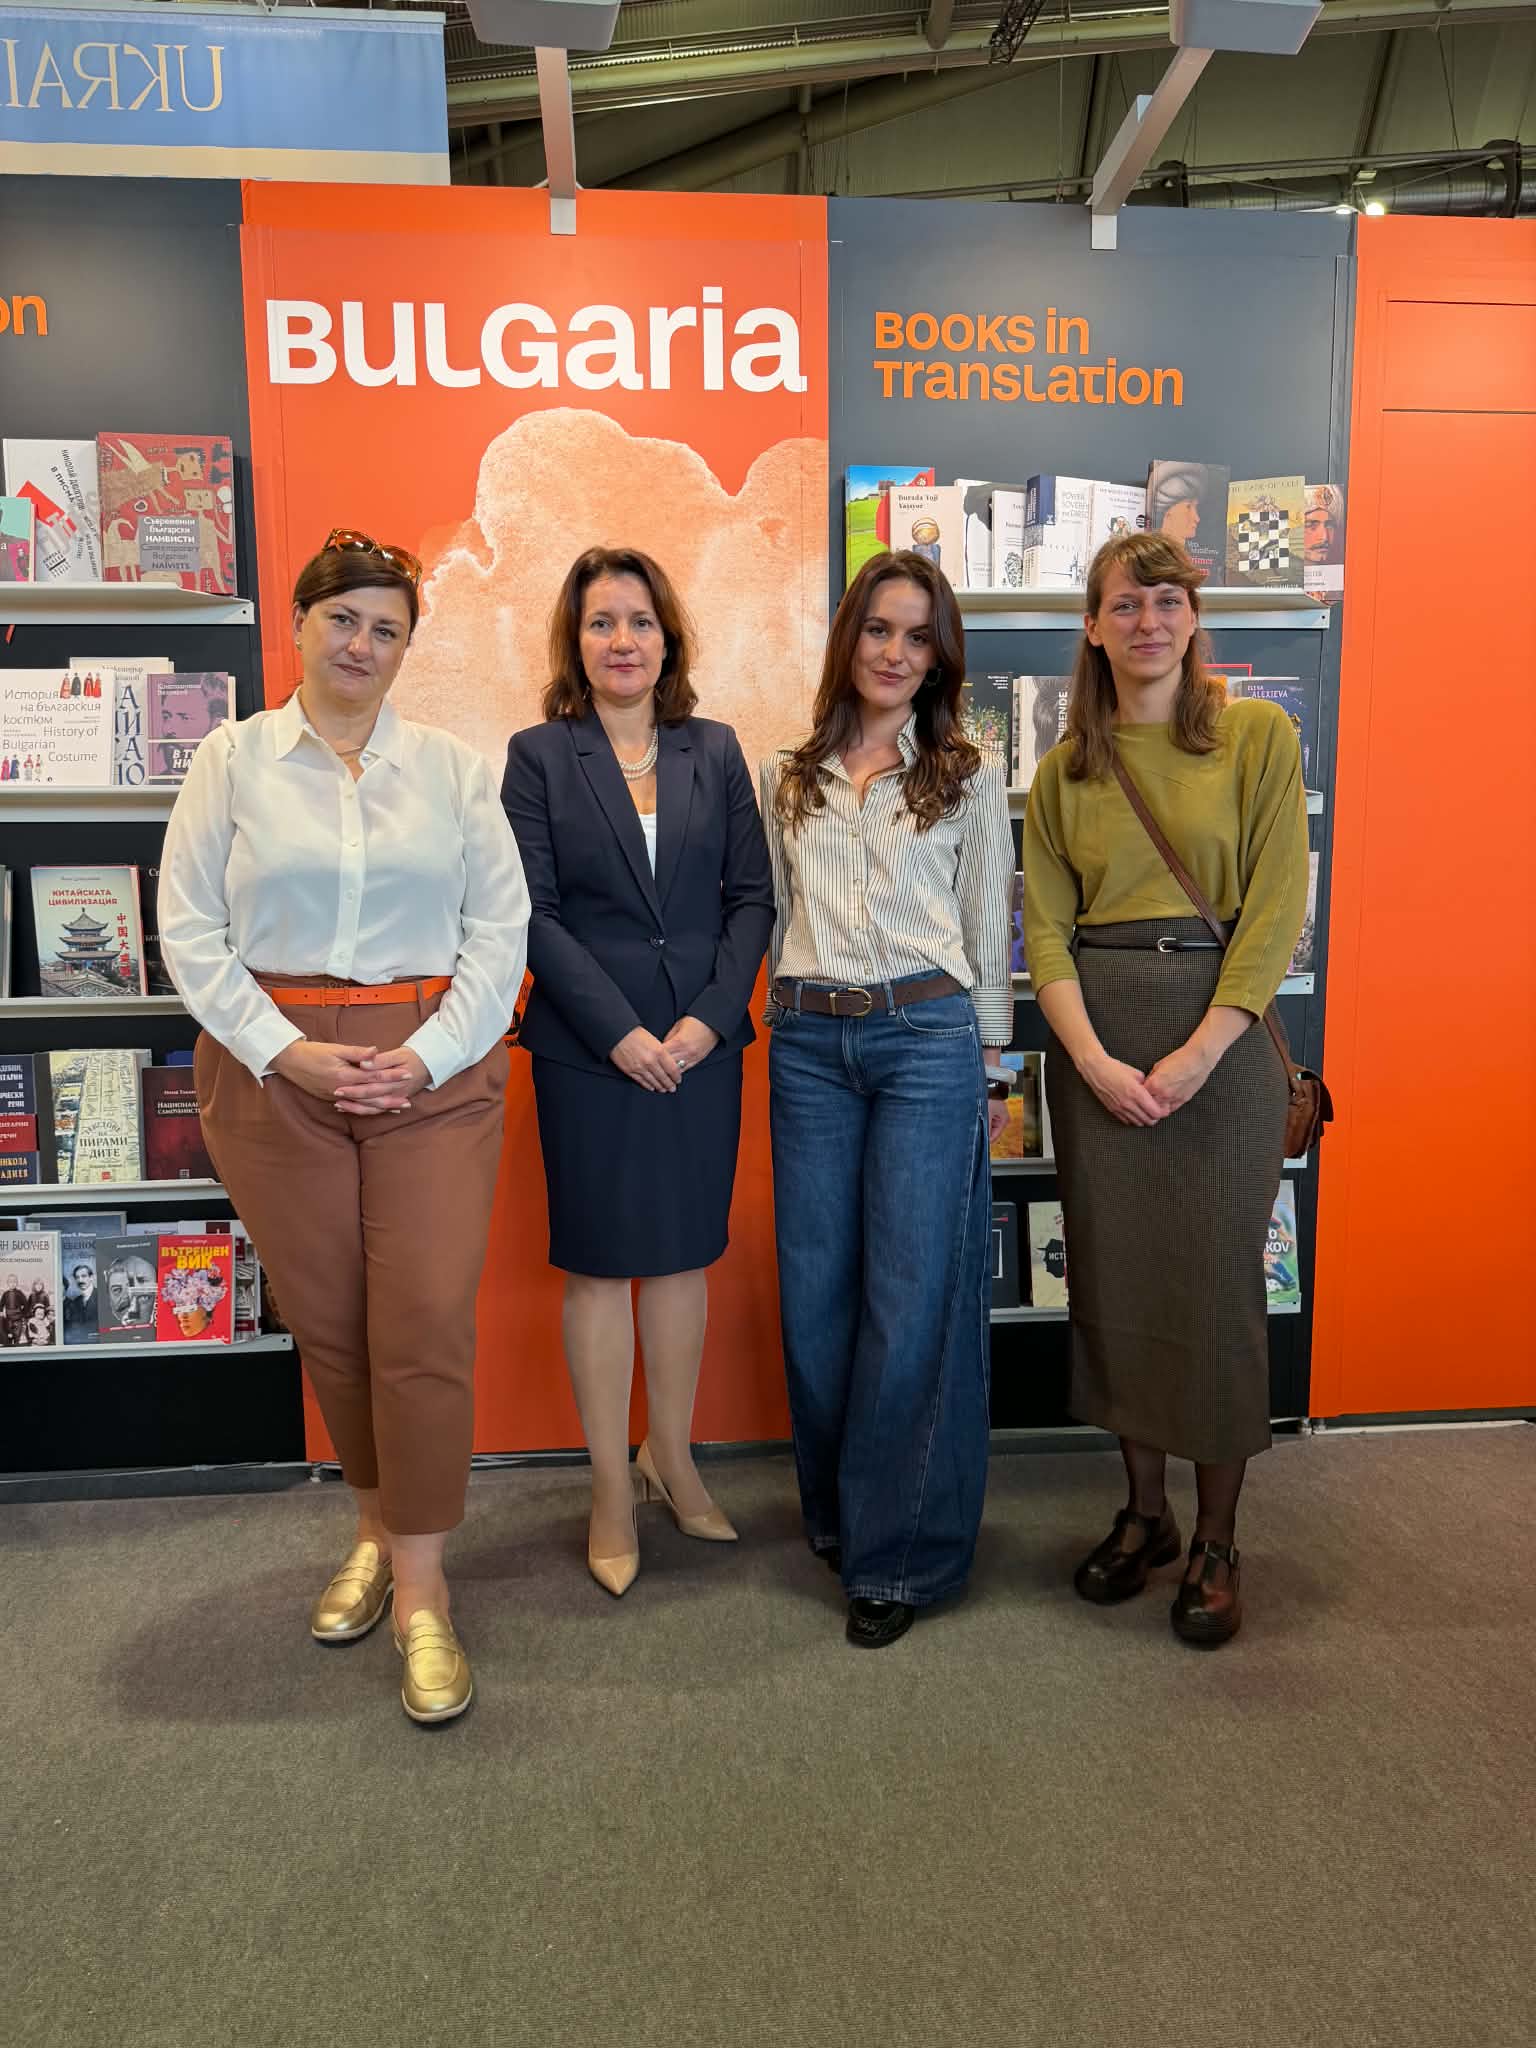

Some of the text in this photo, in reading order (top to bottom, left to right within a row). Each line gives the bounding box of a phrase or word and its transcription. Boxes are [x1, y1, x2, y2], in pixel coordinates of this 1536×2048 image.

[1046, 307, 1090, 355] in
[4, 689, 60, 702] История
[20, 701, 101, 714] на българския
[3, 713, 53, 725] костюм
[43, 726, 90, 740] History
[90, 725, 99, 737] of
[2, 739, 56, 752] Bulgarian
[48, 751, 98, 762] Costume
[52, 888, 112, 897] КИТАЙСКАТА
[48, 898, 118, 906] ЦИВИЛИЗАЦИЯ
[79, 1136, 128, 1147] ПИРАМИ
[161, 1246, 230, 1257] ВЪТРЕШЕН
[1266, 1241, 1290, 1253] KOV
[176, 1255, 213, 1270] ВИК
